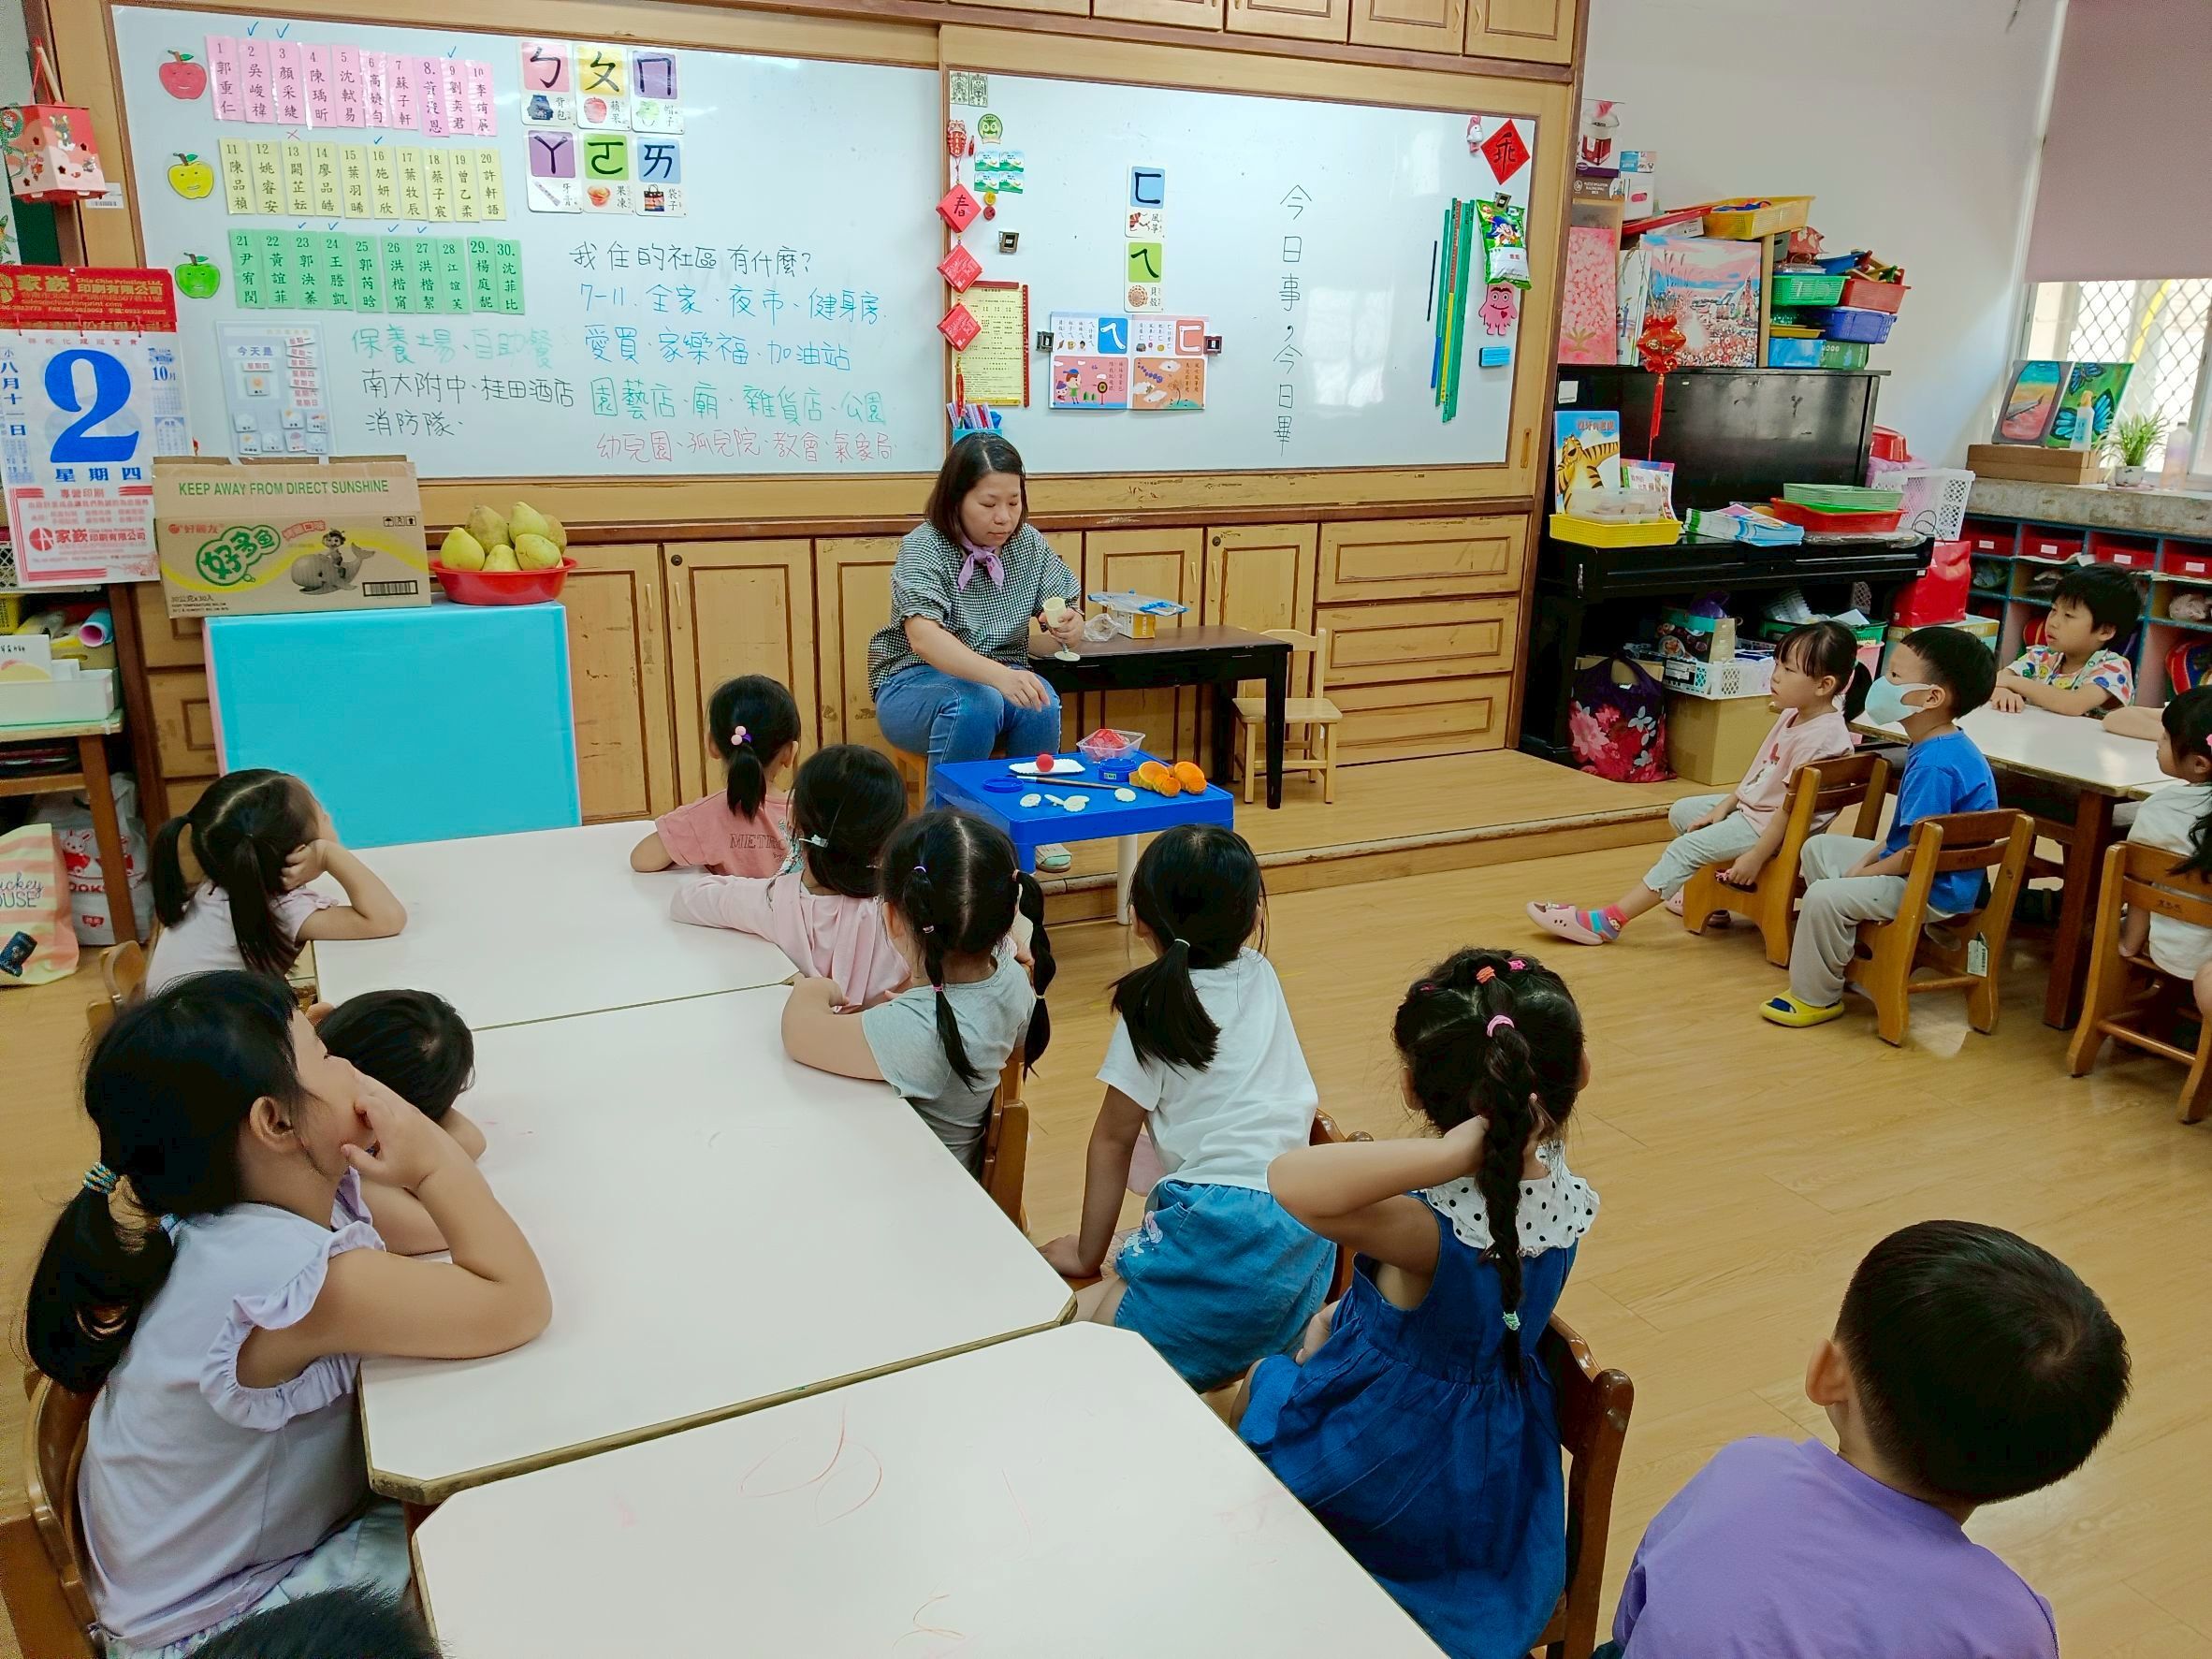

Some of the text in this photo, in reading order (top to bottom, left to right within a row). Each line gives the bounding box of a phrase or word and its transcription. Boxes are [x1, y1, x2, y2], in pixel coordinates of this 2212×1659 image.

[248, 46, 255, 57] 2
[279, 48, 285, 59] 3
[310, 52, 317, 63] 4
[341, 52, 347, 63] 5
[369, 58, 374, 67] 6
[217, 43, 236, 113] 1 郭重仁
[473, 68, 484, 78] 10
[395, 61, 412, 125] 7 蘇子軒
[449, 65, 465, 130] 9 劉奕君
[226, 144, 237, 154] 11
[256, 144, 269, 154] 12
[288, 146, 299, 157] 13
[1492, 132, 1517, 176] 乖
[345, 150, 357, 160] 15
[316, 148, 334, 211] 14 廖品皓
[373, 151, 394, 214] 16 施妍欣
[402, 153, 420, 216] 17 葉牧辰
[481, 153, 500, 215] 20 許軒語
[429, 154, 447, 218] 18 蔡子宸
[456, 155, 473, 218] 19 曾乙柔
[953, 195, 969, 217] 春
[237, 236, 248, 246] 21
[267, 236, 279, 247] 22
[297, 238, 310, 248] 23
[327, 240, 338, 249] 24
[357, 241, 369, 252] 25
[387, 242, 400, 253] 26
[416, 243, 429, 254] 27
[443, 244, 456, 255] 28
[502, 263, 518, 310] 沈菲比
[238, 346, 273, 357] 今天是
[44, 349, 139, 463] 2
[55, 467, 142, 482] 星期四
[179, 480, 389, 496] KEEP AWAY FROM DIRECT SUNSHINE
